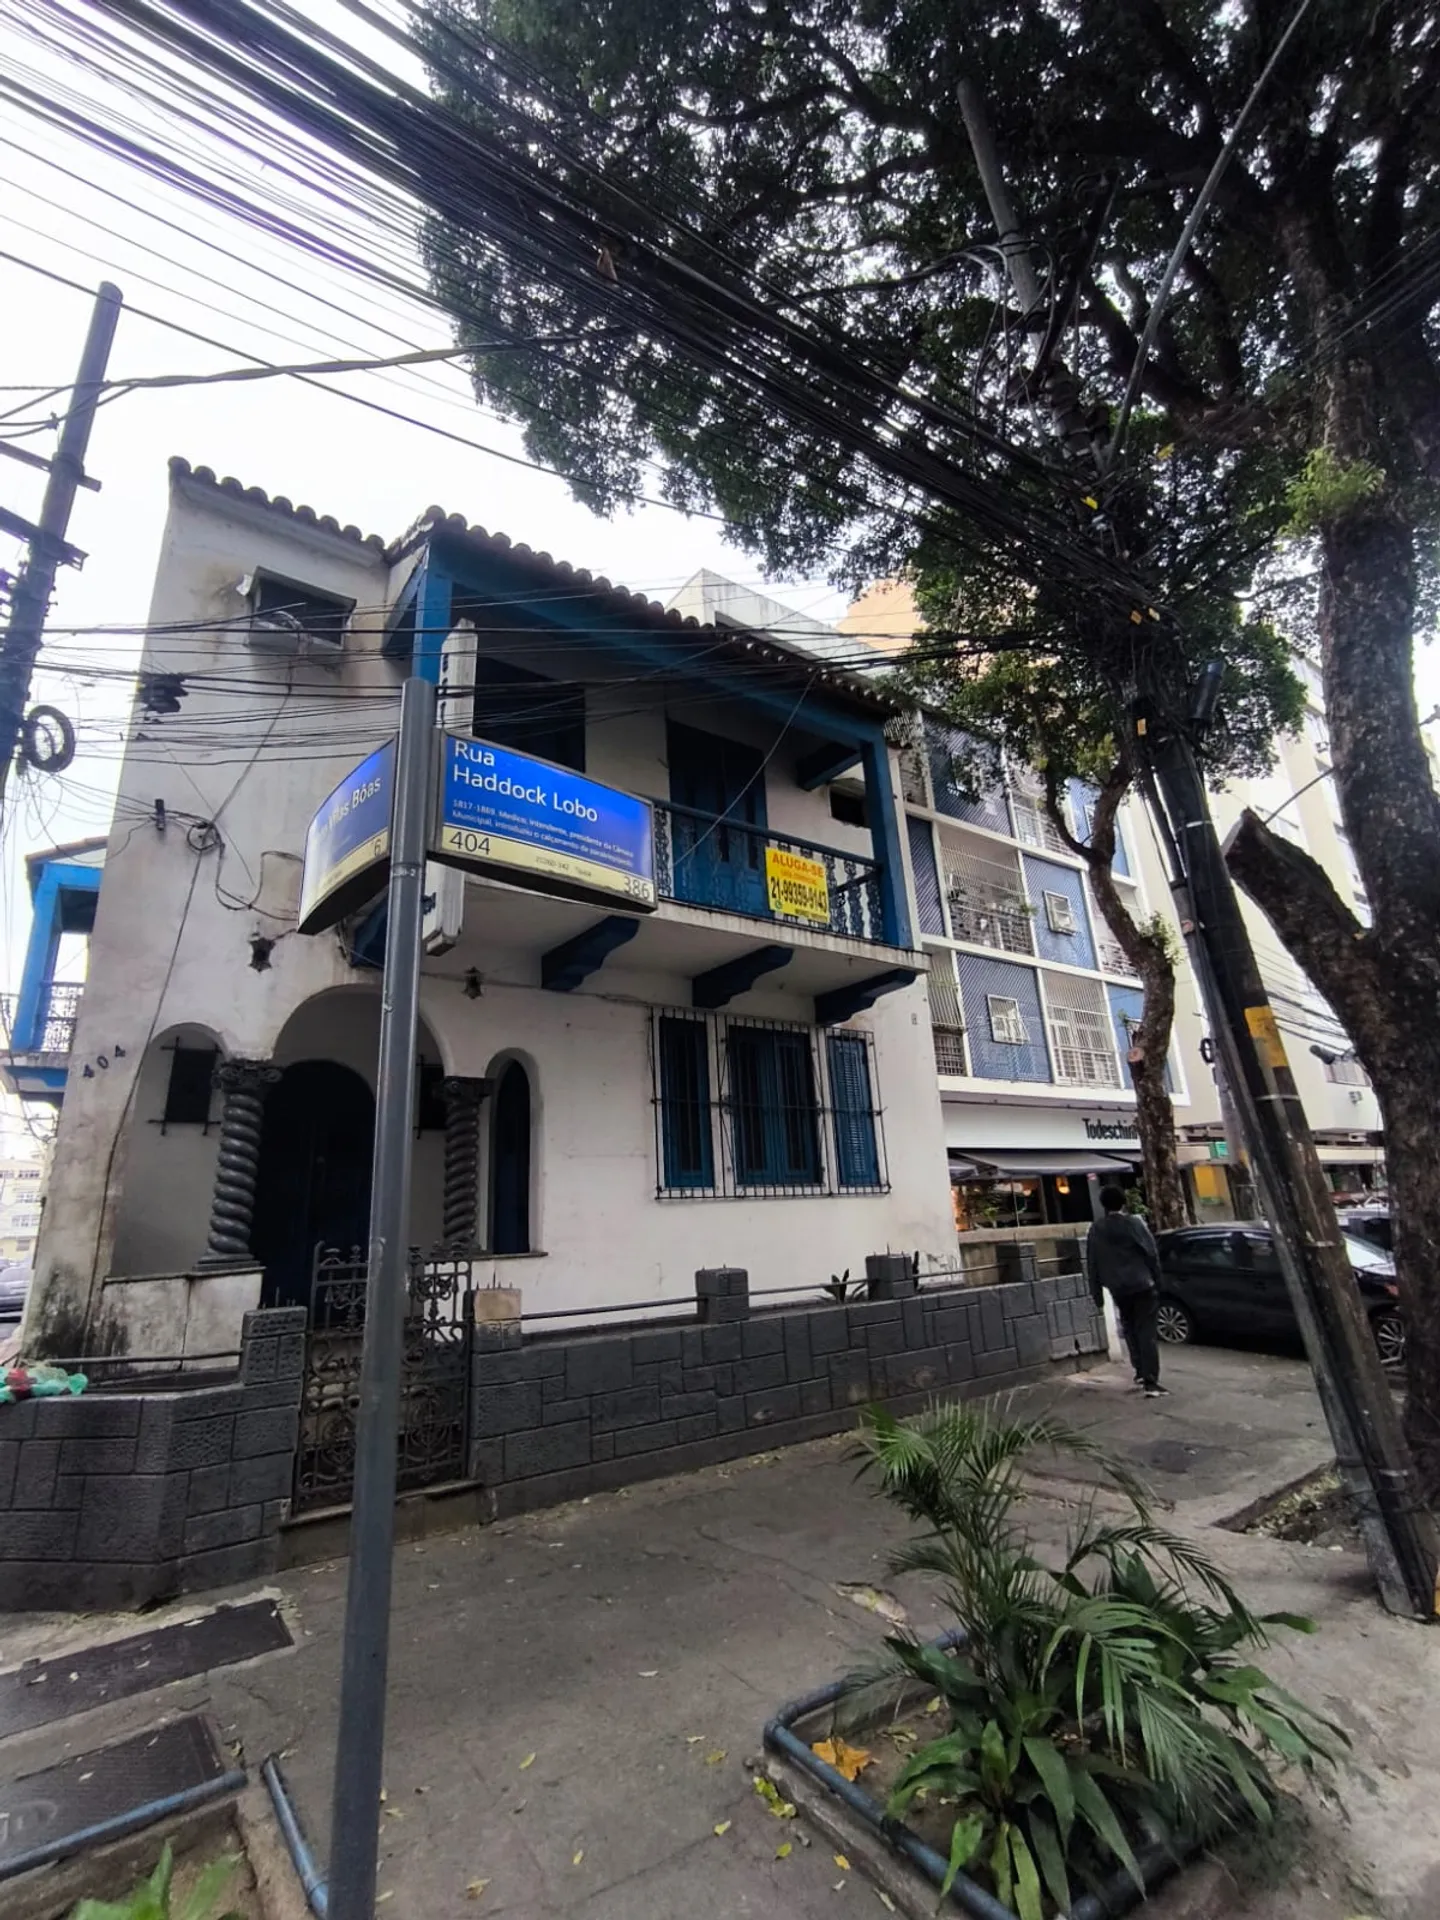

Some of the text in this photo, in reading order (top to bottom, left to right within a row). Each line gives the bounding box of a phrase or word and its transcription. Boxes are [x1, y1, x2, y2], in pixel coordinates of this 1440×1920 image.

[455, 740, 495, 767] Rua
[453, 764, 598, 822] Haddock Lobo
[450, 831, 490, 855] 404
[624, 876, 650, 900] 386
[772, 852, 824, 878] ALUGA-SE
[83, 1045, 126, 1079] 404
